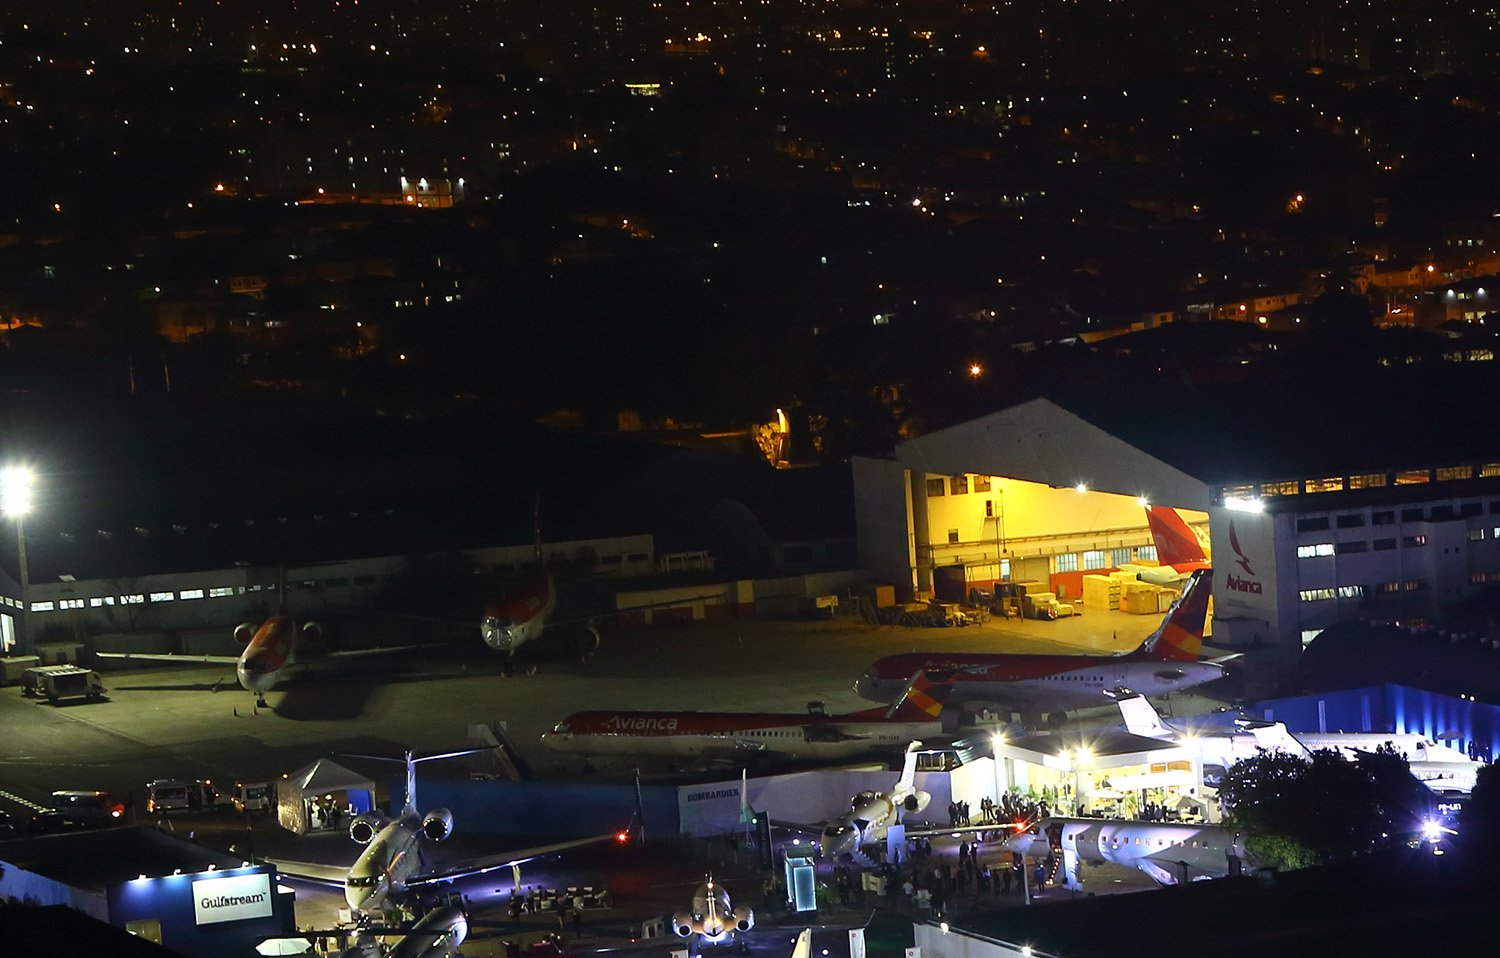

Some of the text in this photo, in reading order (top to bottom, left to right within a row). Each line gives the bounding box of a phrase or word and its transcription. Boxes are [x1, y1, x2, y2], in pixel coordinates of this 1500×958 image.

[1226, 573, 1262, 595] Avianca
[607, 715, 678, 730] Avianca
[687, 787, 740, 803] BOMBARDIER
